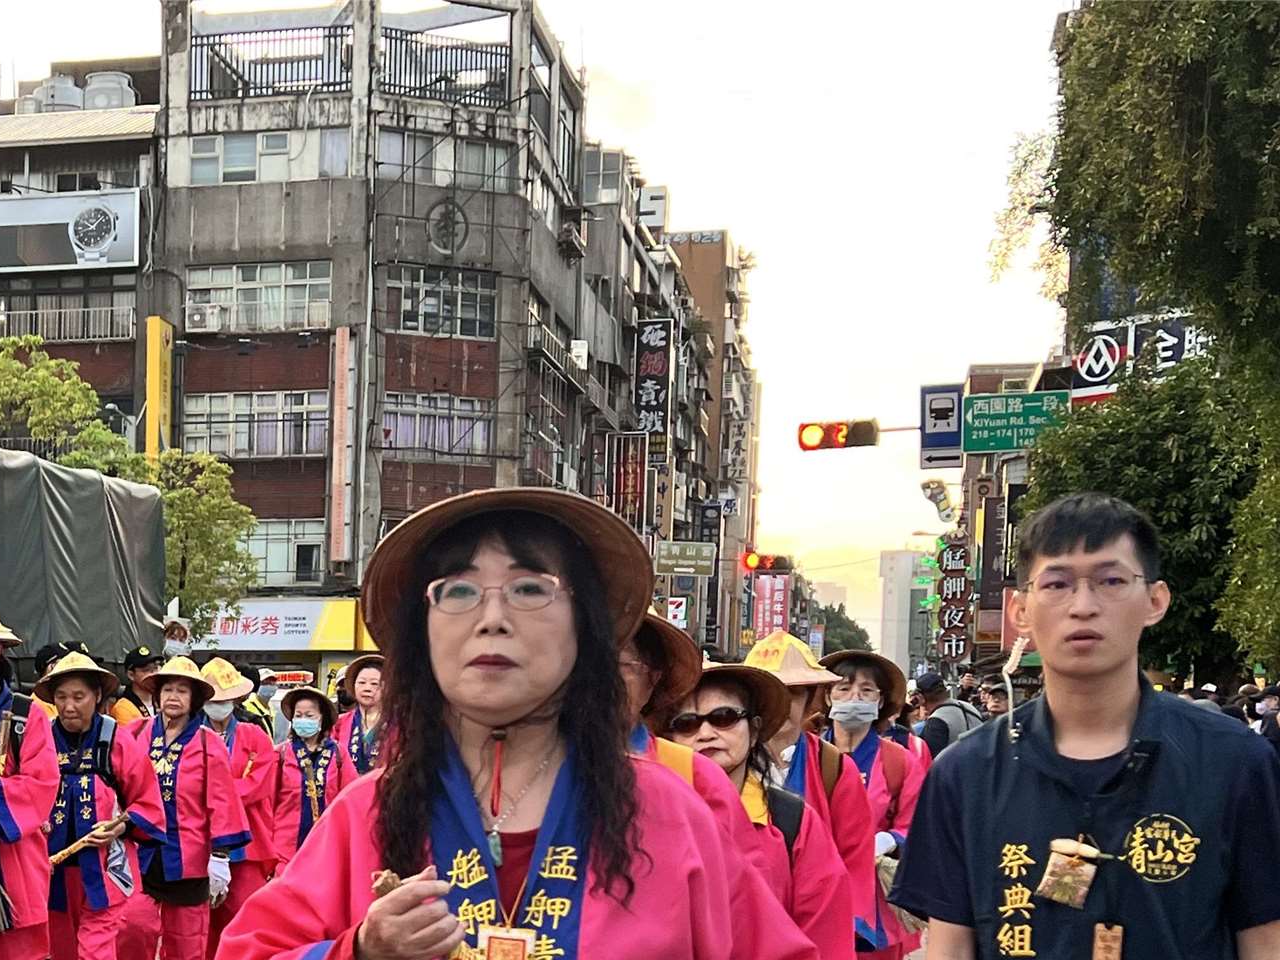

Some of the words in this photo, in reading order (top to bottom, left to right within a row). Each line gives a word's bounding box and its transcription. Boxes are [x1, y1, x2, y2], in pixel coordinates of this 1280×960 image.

[942, 549, 967, 657] 艋舺夜市
[997, 843, 1037, 958] 祭典組
[1118, 826, 1201, 874] 青山宮
